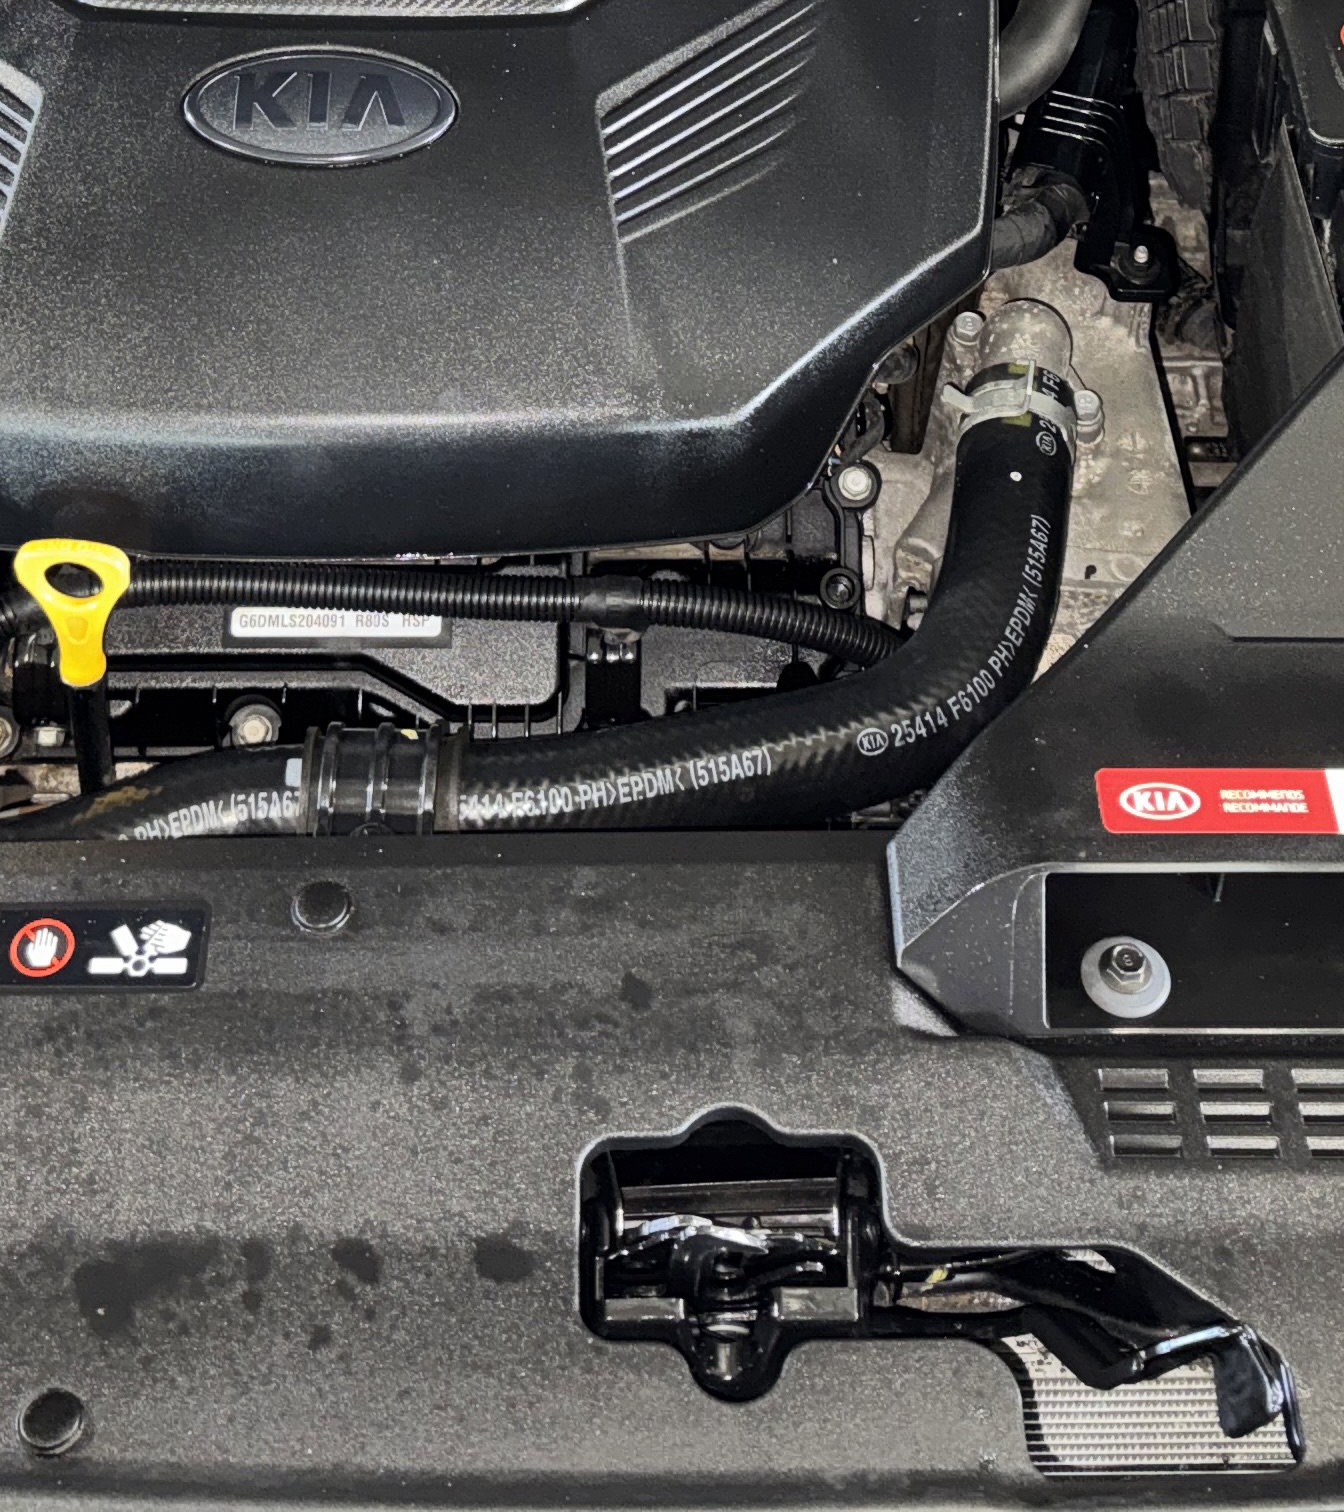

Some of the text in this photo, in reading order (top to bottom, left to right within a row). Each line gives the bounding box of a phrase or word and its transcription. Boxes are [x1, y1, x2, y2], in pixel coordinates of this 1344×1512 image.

[231, 71, 407, 131] KIA
[859, 730, 887, 755] KIA
[890, 705, 949, 748] 25414
[946, 668, 997, 721] F6100
[1022, 514, 1052, 587] (515A67)
[689, 745, 773, 791] (515A67)
[1133, 791, 1189, 812] KIA
